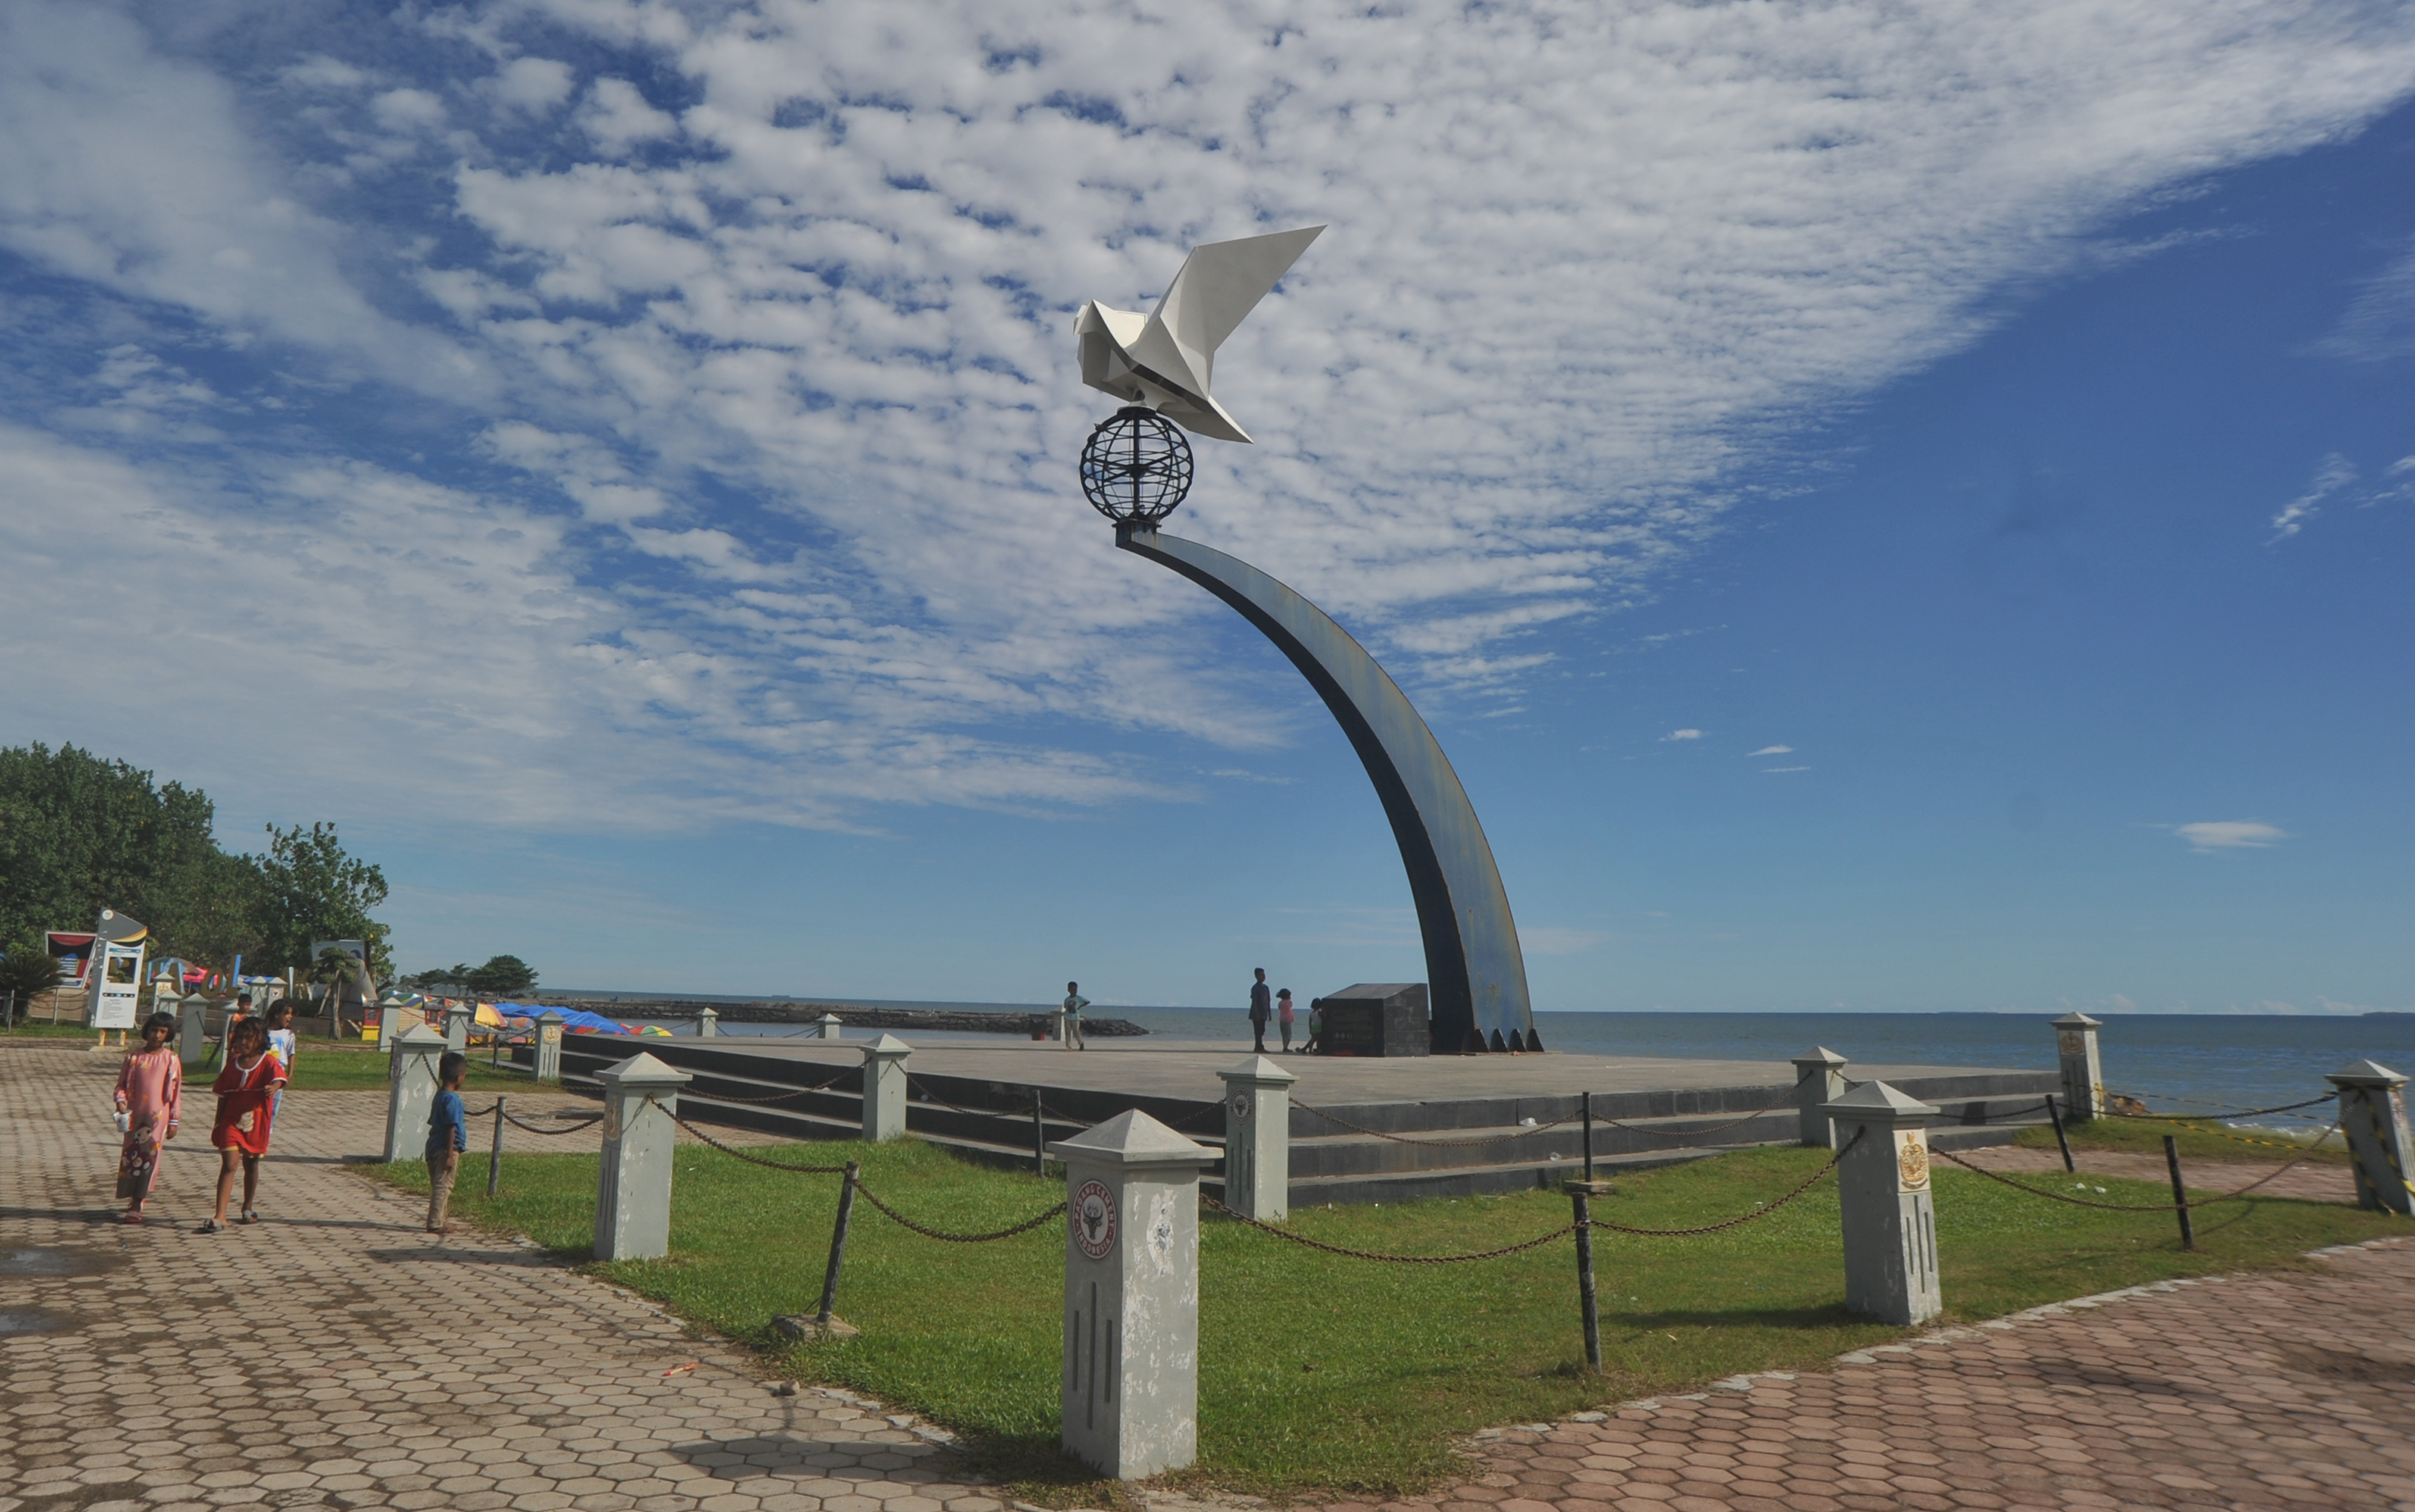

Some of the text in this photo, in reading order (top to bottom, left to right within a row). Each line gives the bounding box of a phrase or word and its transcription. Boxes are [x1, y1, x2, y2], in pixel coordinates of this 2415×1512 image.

[1075, 1185, 1115, 1228] PADANG CEMENT
[1076, 1230, 1112, 1255] INDONESIA
